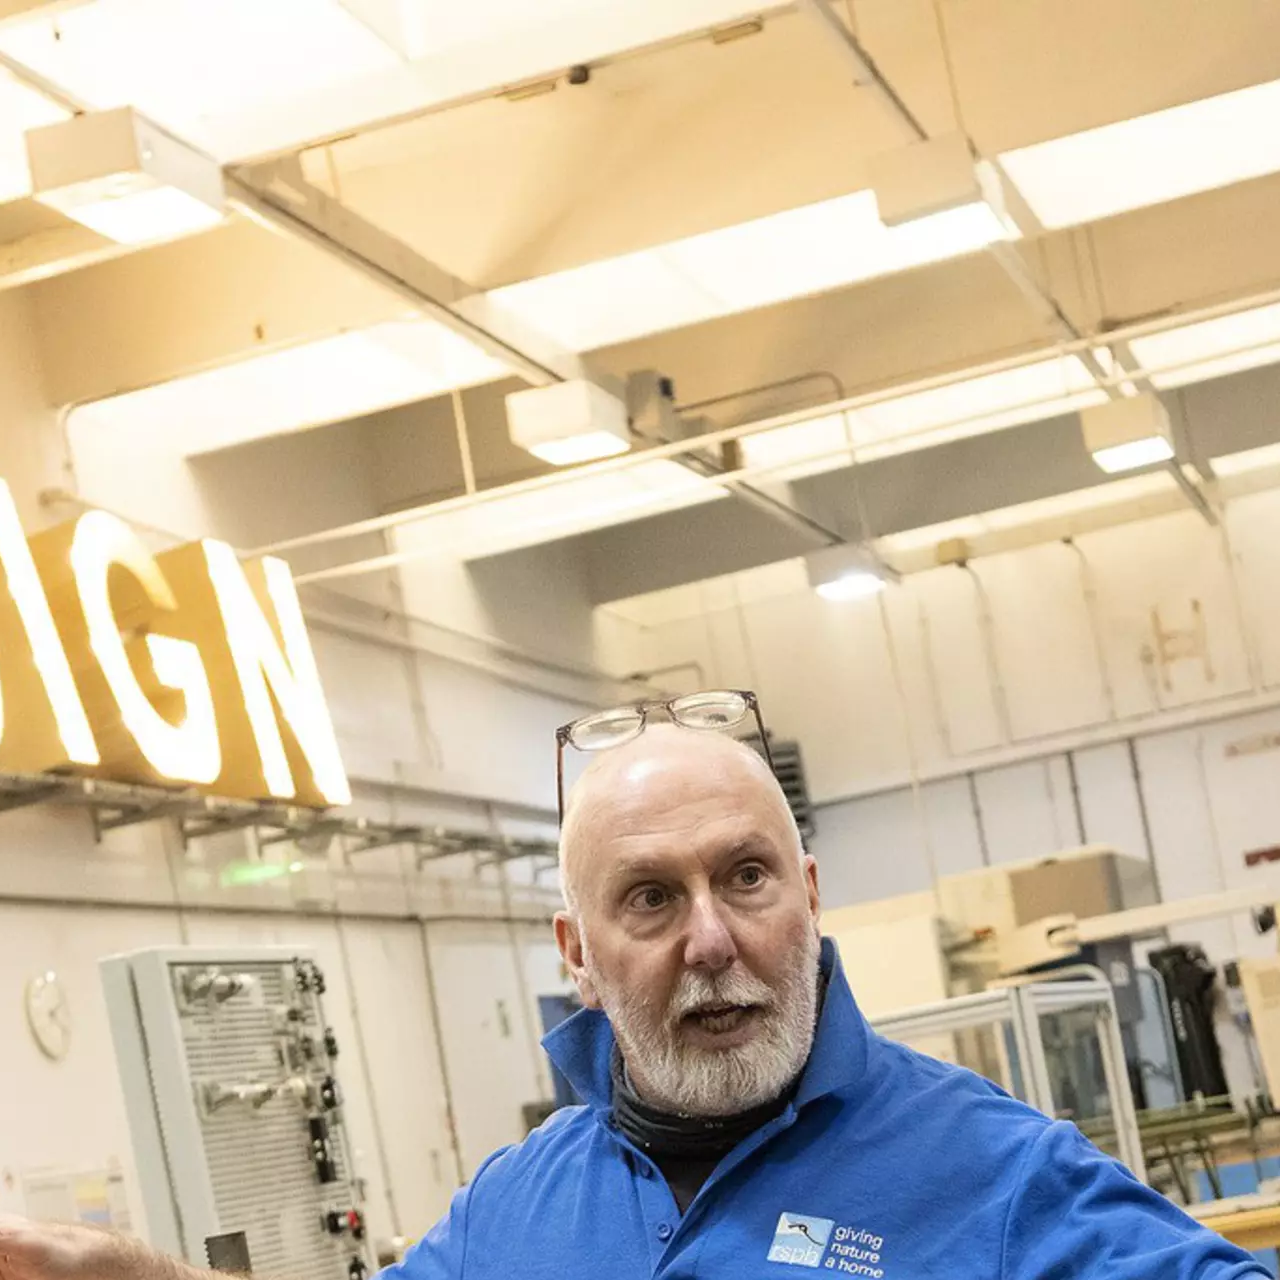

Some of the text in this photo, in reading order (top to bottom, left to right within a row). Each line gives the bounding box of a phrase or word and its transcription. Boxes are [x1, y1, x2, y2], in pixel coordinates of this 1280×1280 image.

[834, 1225, 884, 1250] giving
[830, 1242, 880, 1264] nature
[824, 1257, 884, 1279] a home
